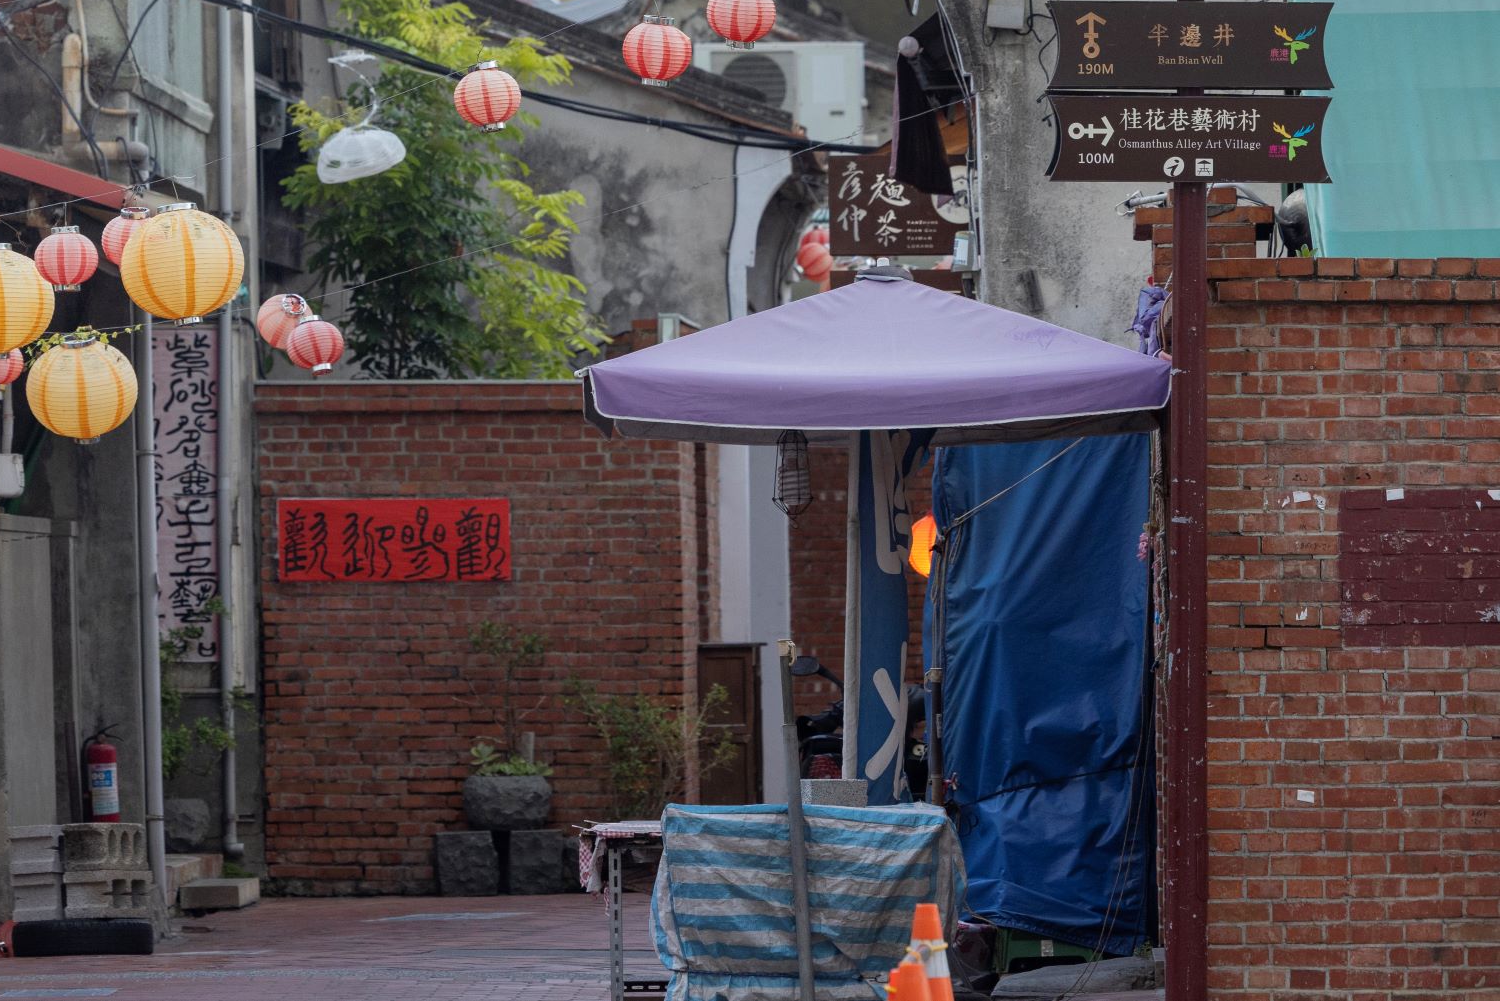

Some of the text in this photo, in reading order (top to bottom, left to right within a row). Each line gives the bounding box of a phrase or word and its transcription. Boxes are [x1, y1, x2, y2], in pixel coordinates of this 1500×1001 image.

[1147, 23, 1235, 48] 半邊井
[1157, 55, 1224, 65] Ban Bian Well
[1077, 63, 1114, 75] 190M
[1119, 108, 1261, 133] 桂花巷藝術村
[1118, 138, 1261, 152] Osmanthus Alley Art Village
[1078, 152, 1115, 165] 100M
